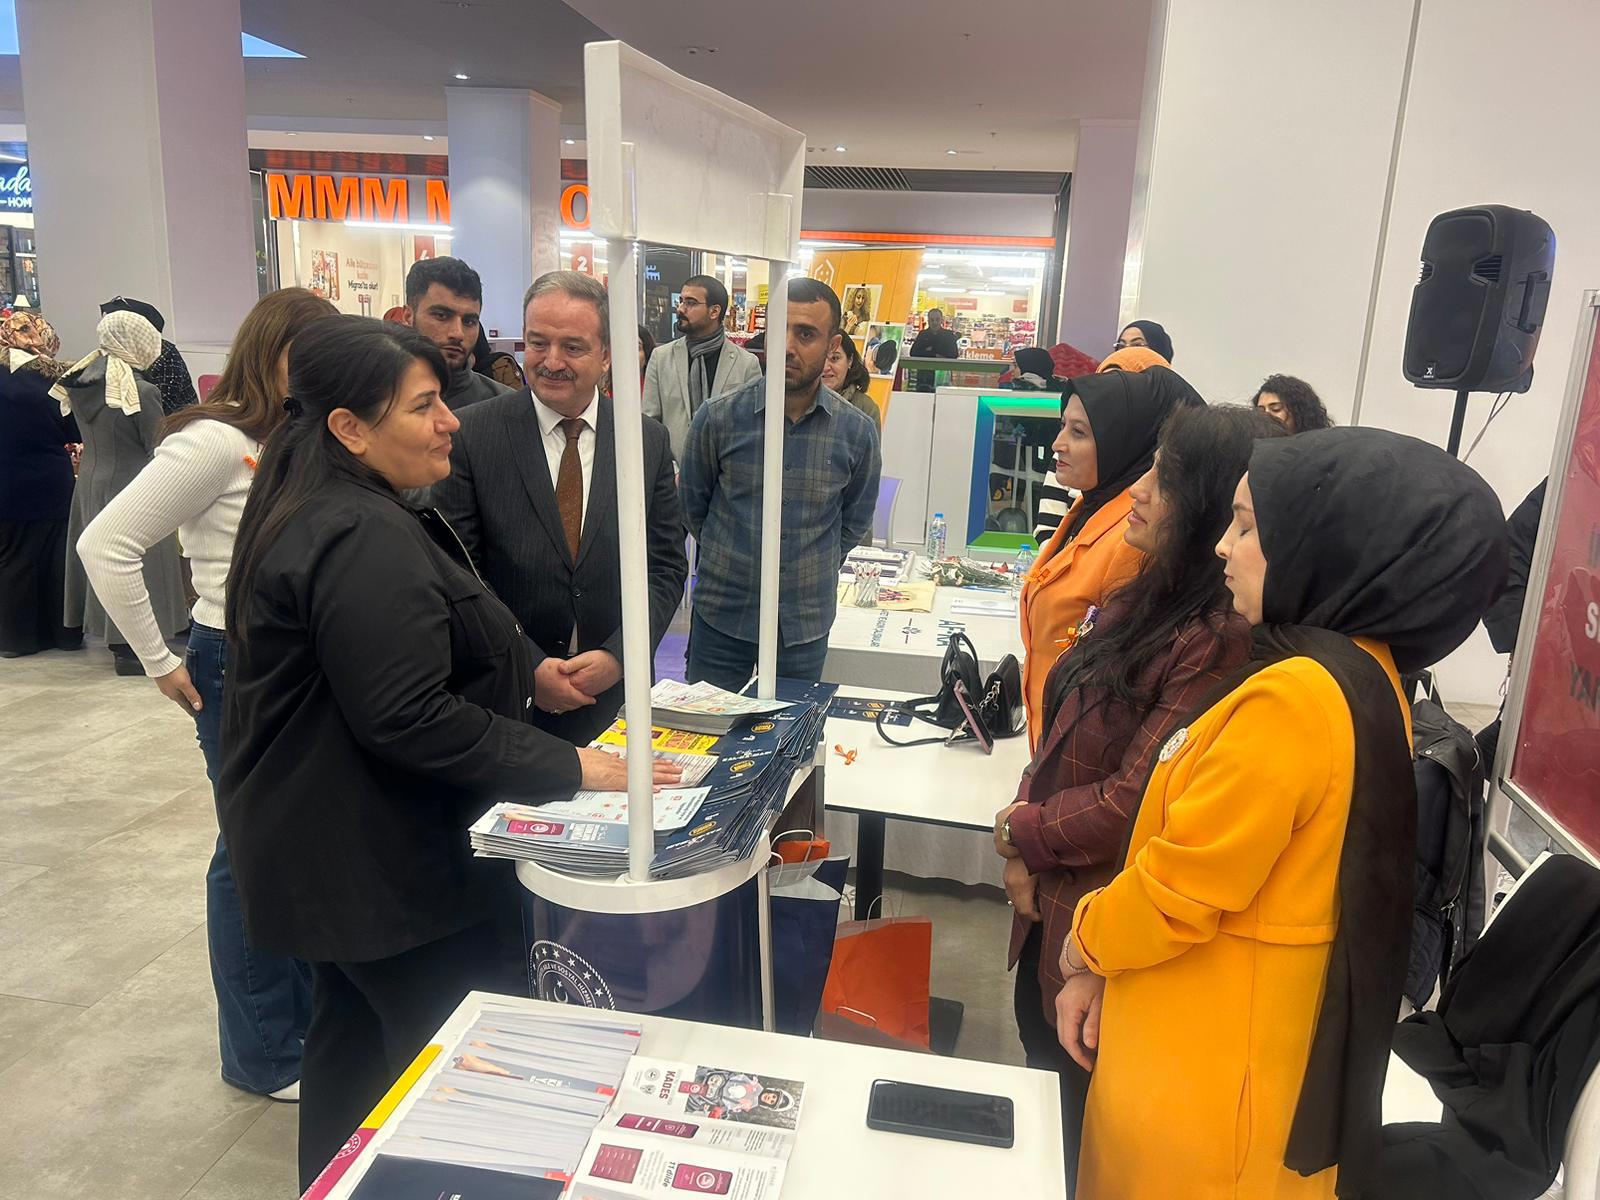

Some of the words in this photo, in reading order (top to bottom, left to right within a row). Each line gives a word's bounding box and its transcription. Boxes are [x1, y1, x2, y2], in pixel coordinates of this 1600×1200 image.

[267, 173, 409, 225] MMM
[577, 256, 588, 272] 2
[557, 965, 578, 985] SOSYAL
[659, 1070, 676, 1100] KADES
